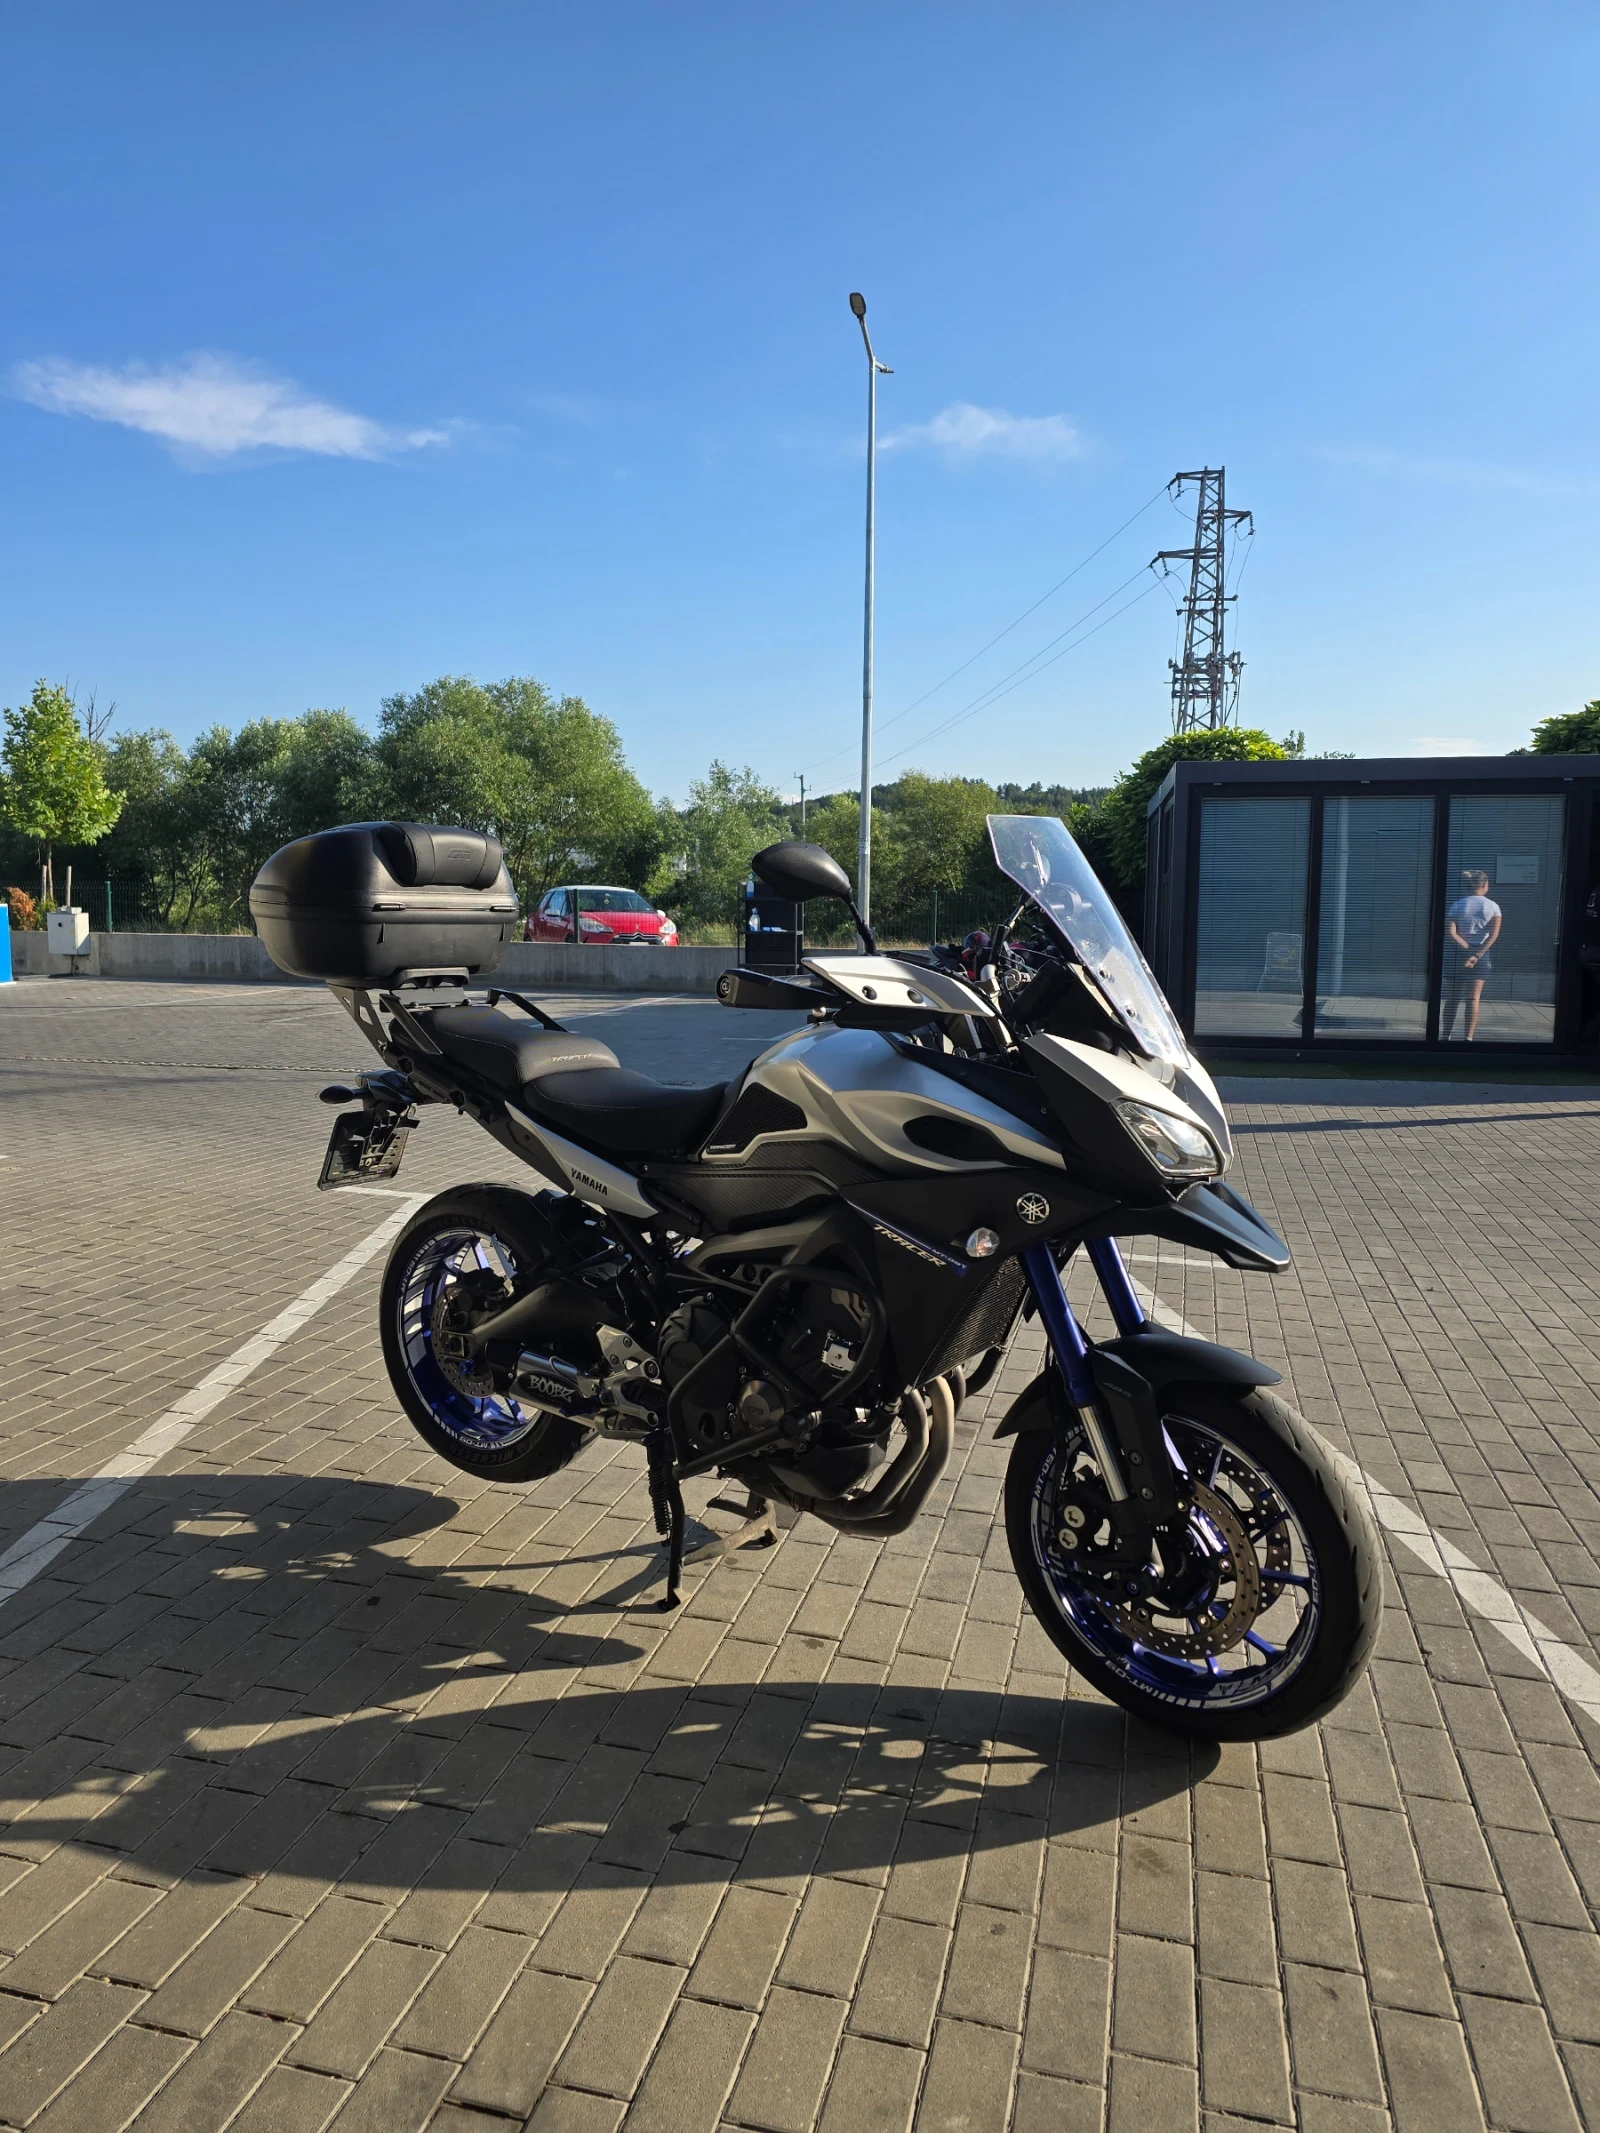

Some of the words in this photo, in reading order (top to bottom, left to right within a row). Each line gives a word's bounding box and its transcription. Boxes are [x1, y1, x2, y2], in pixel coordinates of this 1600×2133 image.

[571, 1167, 608, 1196] YAMAHA
[873, 1223, 947, 1268] TRACER
[527, 1374, 576, 1403] BOOBZ
[459, 1435, 488, 1449] MT-09
[1034, 1453, 1056, 1498] MT-09
[1304, 1546, 1319, 1604] MT-09
[1104, 1659, 1153, 1693] MT-09
